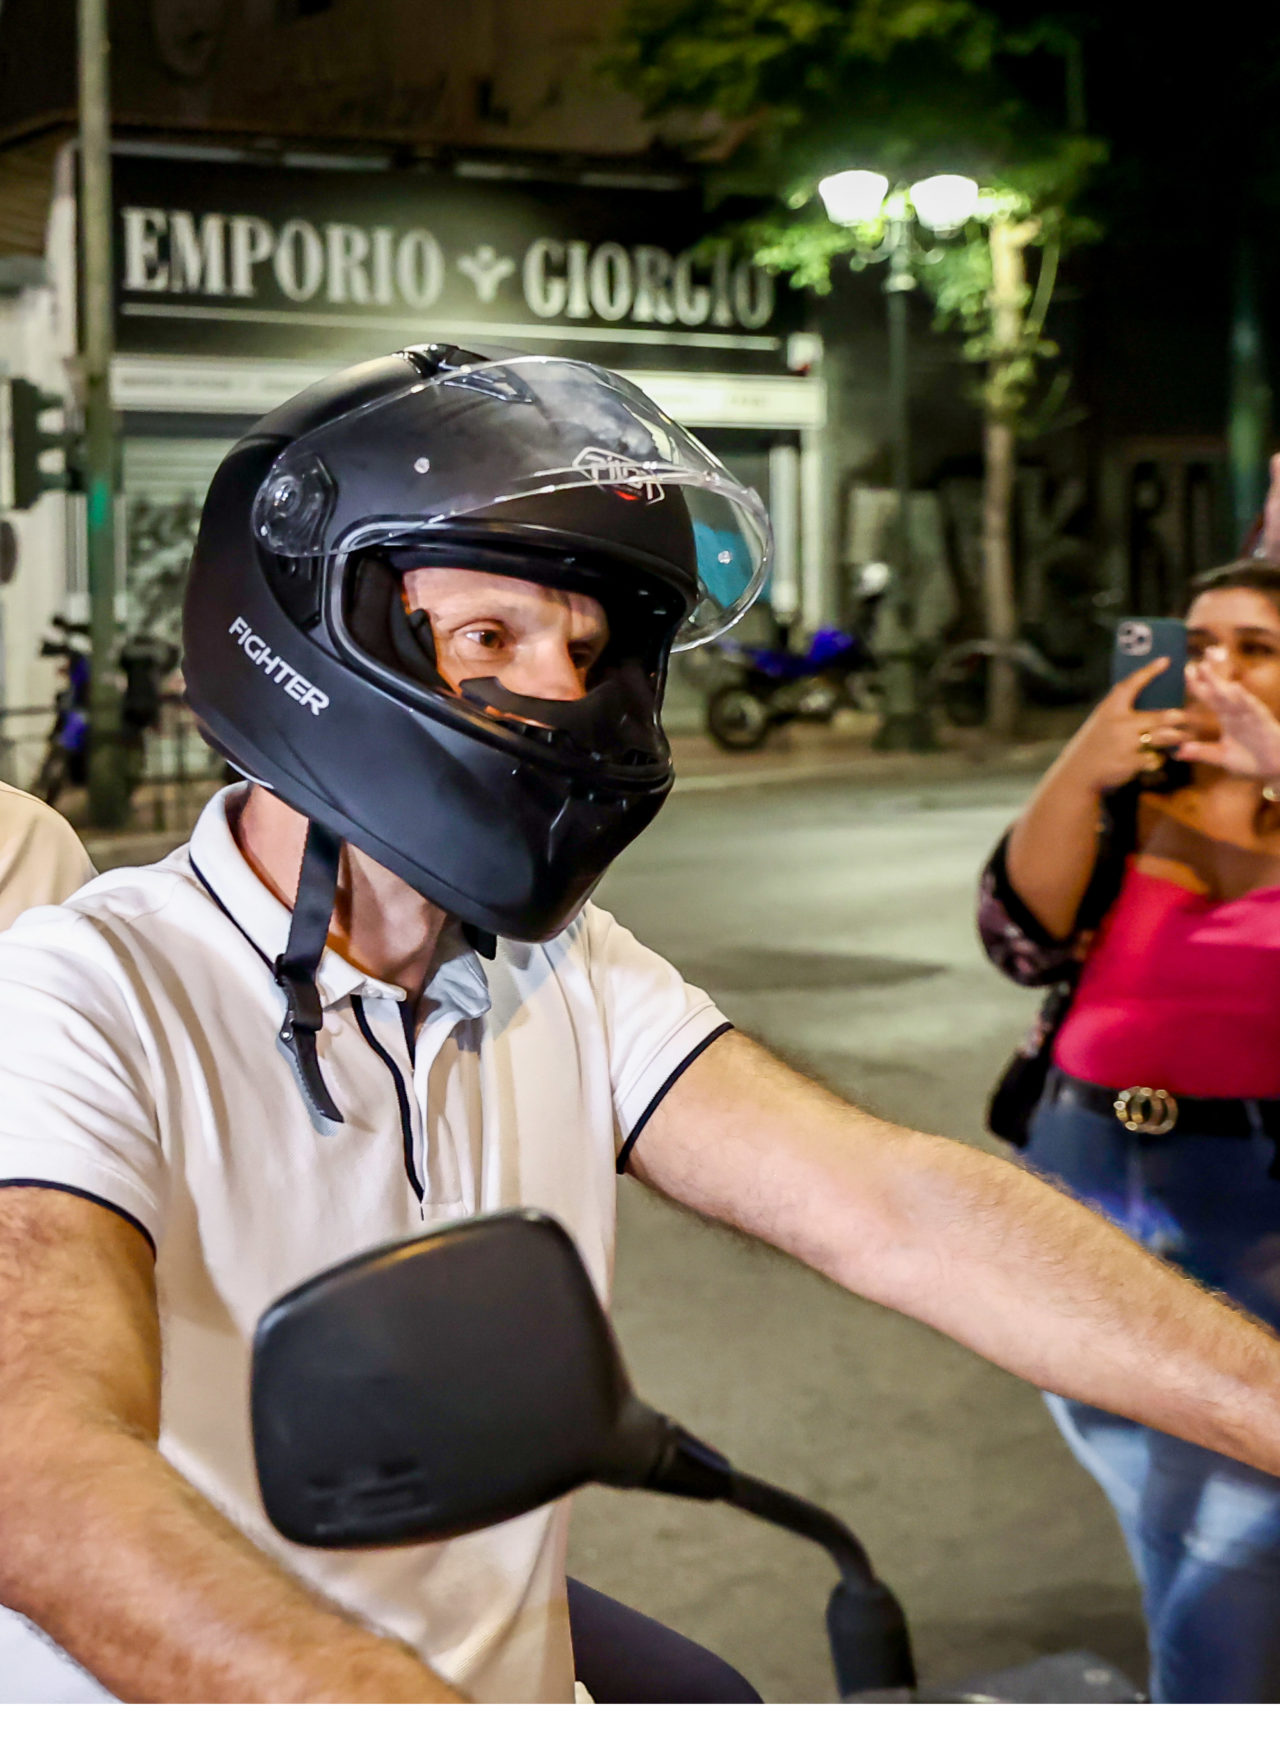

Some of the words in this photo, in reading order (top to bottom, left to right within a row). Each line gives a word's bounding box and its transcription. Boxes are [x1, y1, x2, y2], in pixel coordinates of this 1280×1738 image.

[122, 206, 445, 309] EMPORIO
[522, 238, 774, 329] GIORGIO
[229, 616, 330, 716] FIGHTER
